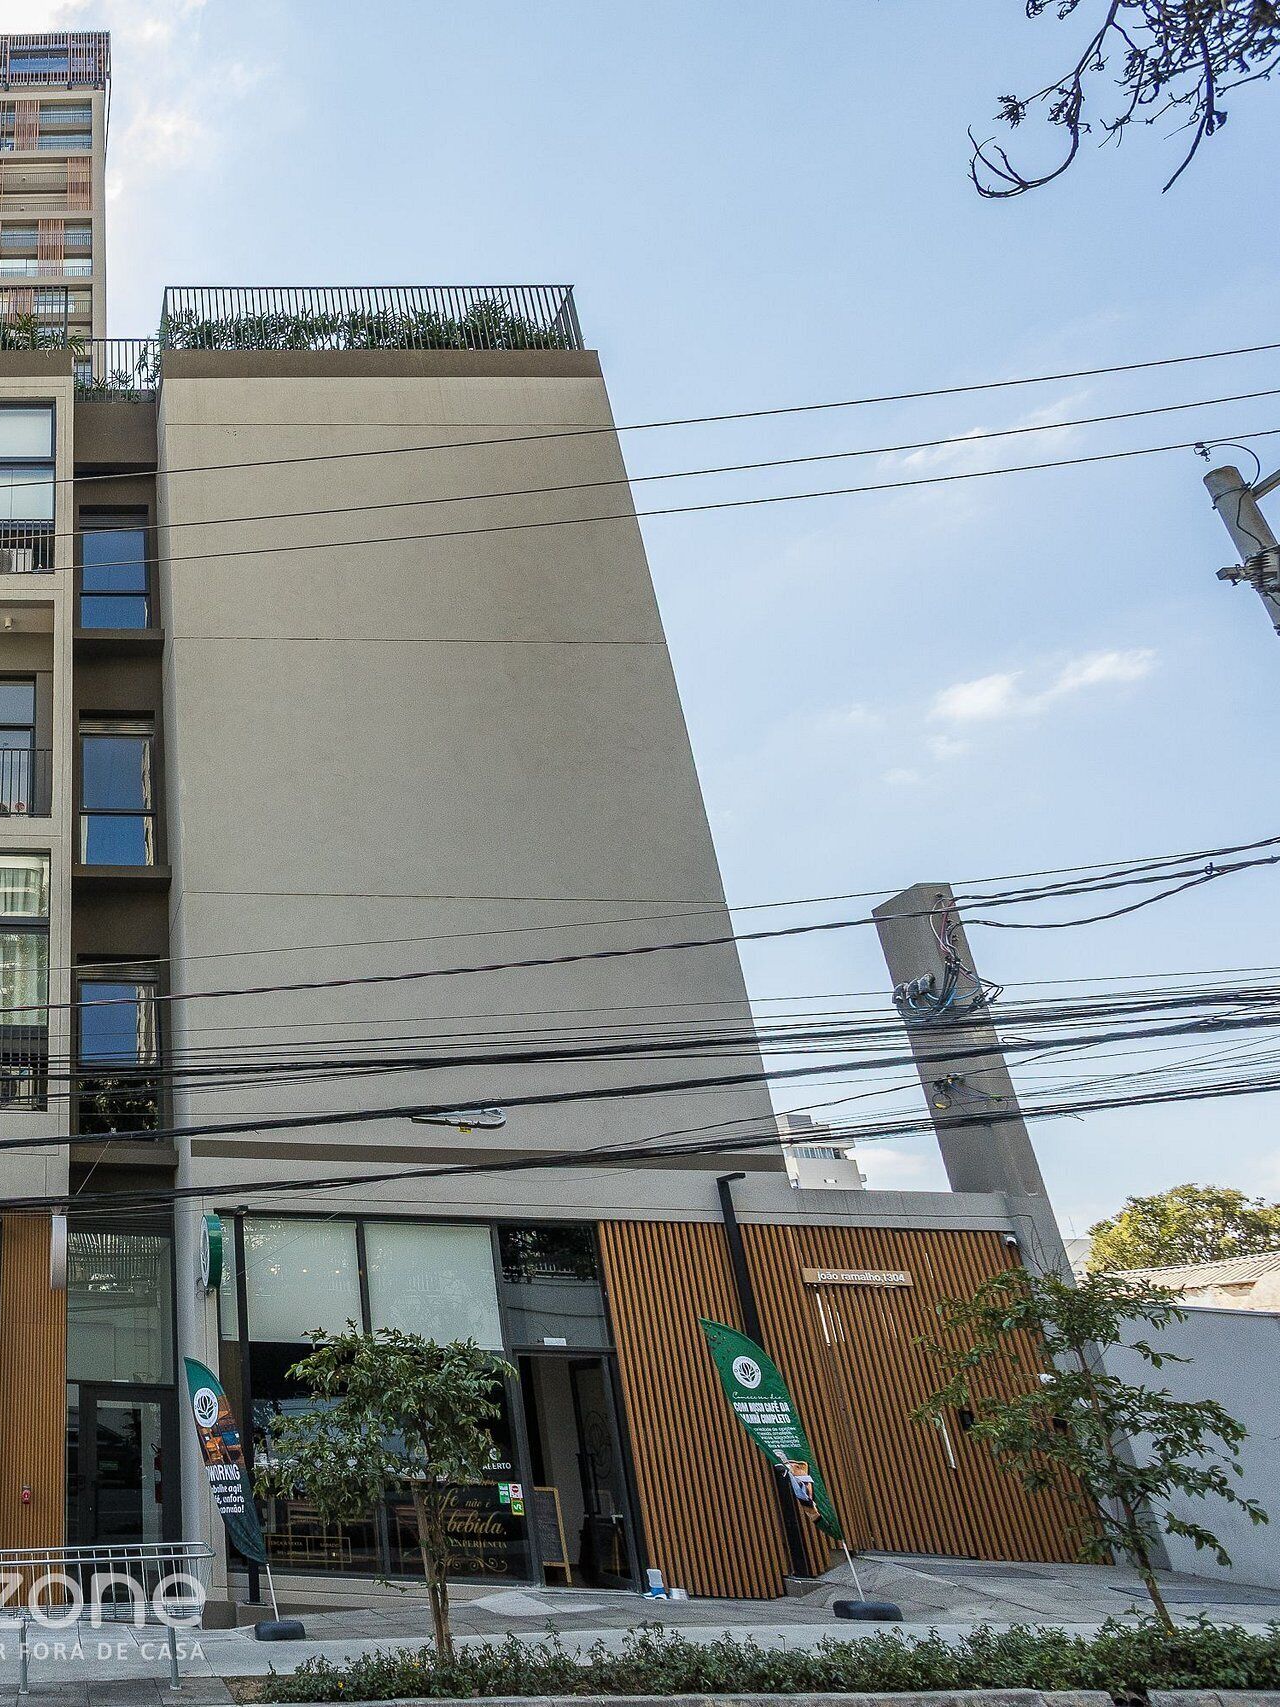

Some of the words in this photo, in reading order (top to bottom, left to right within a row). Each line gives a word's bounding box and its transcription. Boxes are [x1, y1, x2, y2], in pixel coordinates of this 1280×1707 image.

[817, 1271, 839, 1282] joão
[733, 1402, 749, 1412] COM
[763, 1400, 781, 1412] CAFÉ
[779, 1402, 791, 1412] DA
[760, 1413, 791, 1424] COMPLETO
[447, 1509, 508, 1535] bebida.
